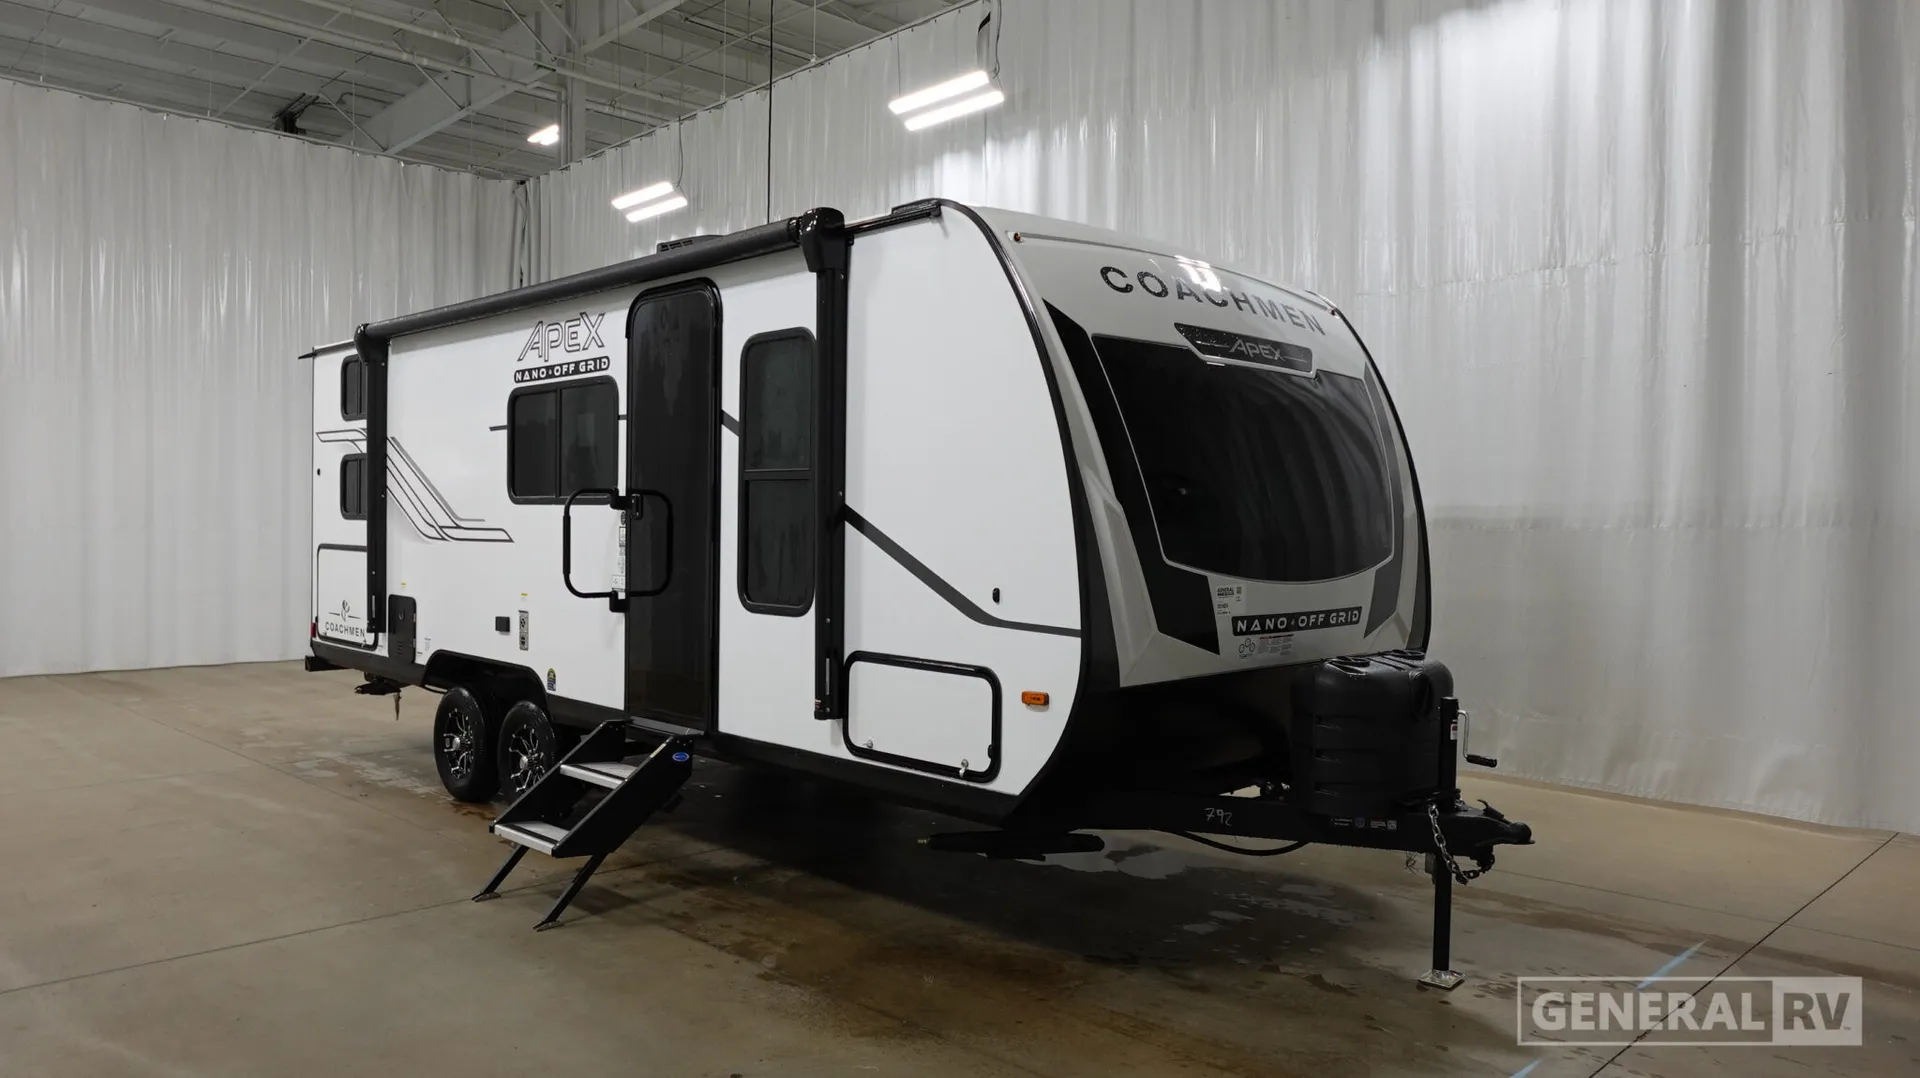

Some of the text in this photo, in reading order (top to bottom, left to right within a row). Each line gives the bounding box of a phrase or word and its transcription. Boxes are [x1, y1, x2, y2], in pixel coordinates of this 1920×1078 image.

[1100, 266, 1325, 335] COACHMEN
[517, 311, 605, 362] APEX
[1229, 338, 1285, 360] APEX
[553, 364, 575, 376] OFF
[578, 358, 609, 372] GRID
[324, 621, 366, 637] COACHMEN
[1298, 612, 1325, 628] OFF
[1329, 610, 1360, 624] GRID
[1204, 807, 1232, 827] 792
